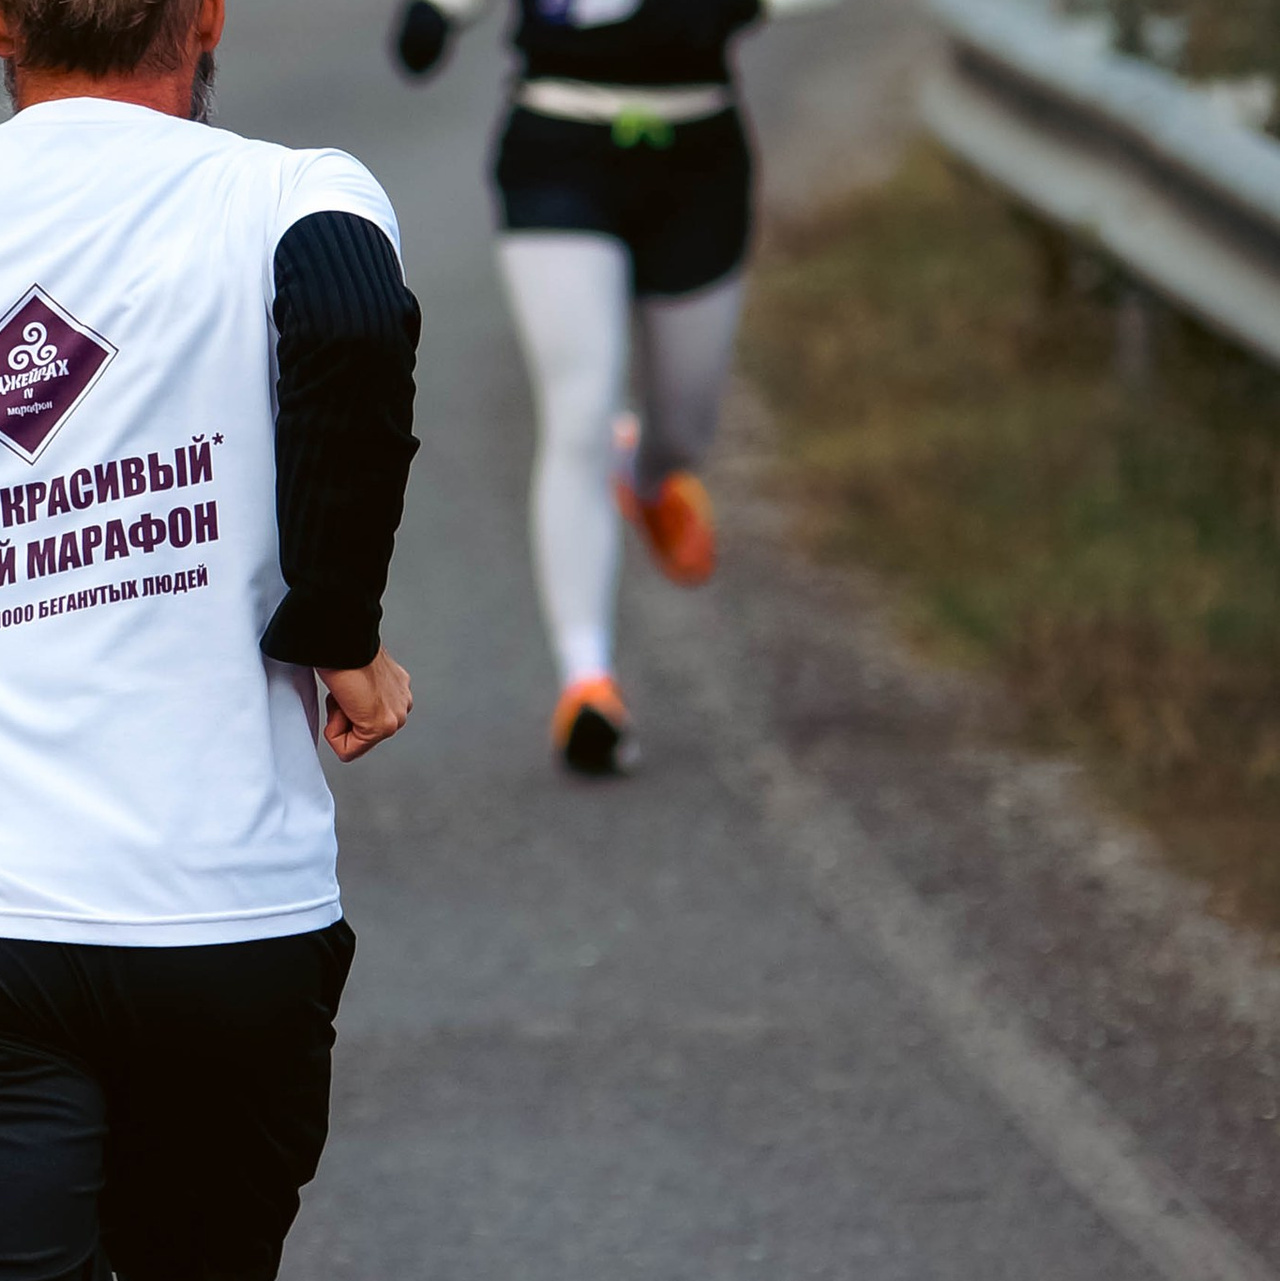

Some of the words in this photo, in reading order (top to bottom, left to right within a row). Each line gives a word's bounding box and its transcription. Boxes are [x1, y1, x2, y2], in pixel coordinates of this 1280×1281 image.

[7, 401, 53, 417] марафон
[23, 388, 34, 399] IV
[26, 500, 219, 580] МАРАФОН
[38, 579, 140, 619] БЕГАНУТЫХ
[141, 563, 209, 597] ЛЮДЕЙ
